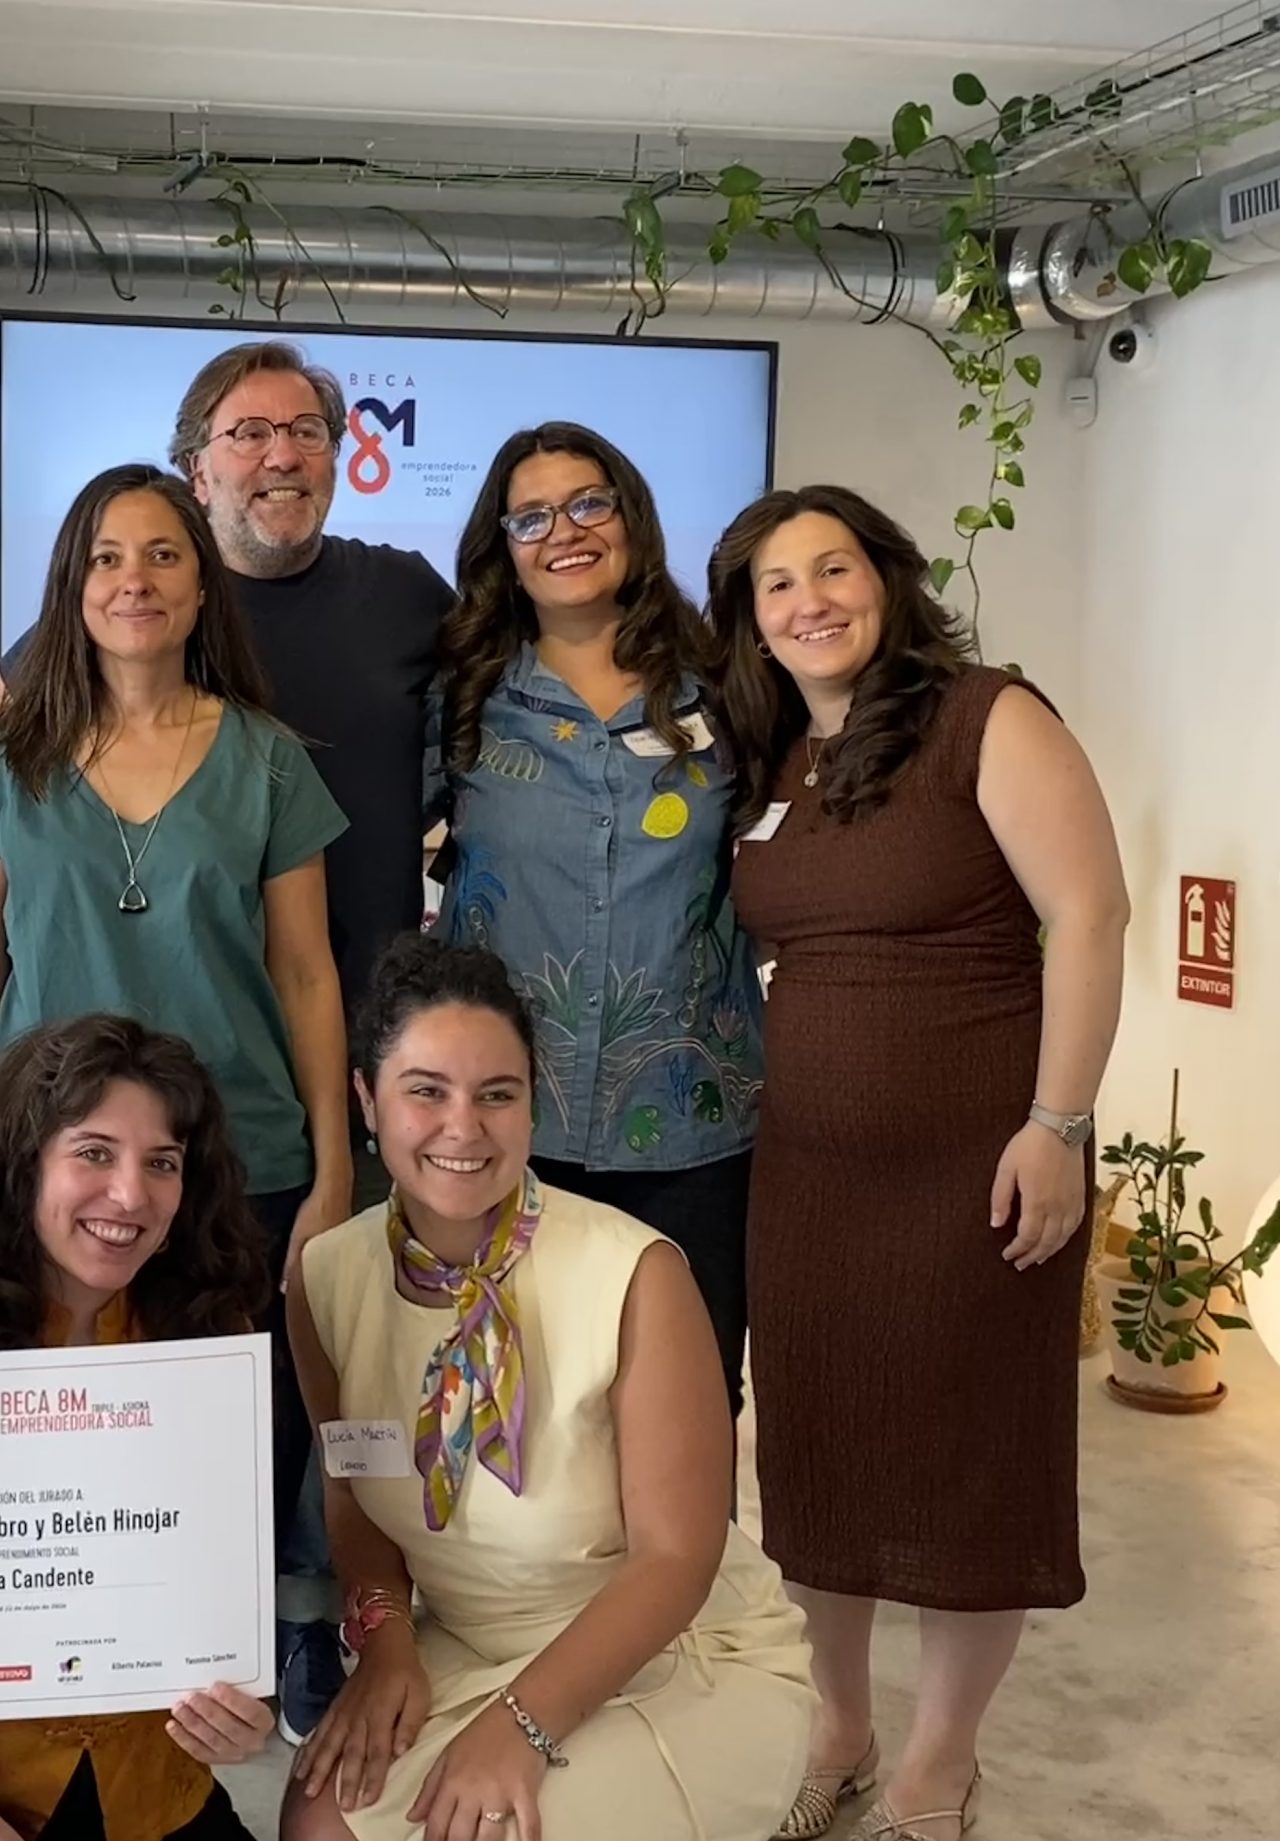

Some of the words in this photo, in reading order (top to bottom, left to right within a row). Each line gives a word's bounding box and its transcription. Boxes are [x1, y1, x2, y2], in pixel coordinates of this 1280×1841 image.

[349, 373, 416, 387] BECA
[401, 461, 477, 472] emprendedora
[423, 473, 454, 483] social
[425, 487, 451, 497] 2026
[1181, 975, 1231, 997] EXTINTOR
[0, 1389, 50, 1417] BECA
[57, 1387, 87, 1412] 8M
[0, 1413, 105, 1435] EMPRENDEDORA
[107, 1410, 154, 1429] SOCIAL
[19, 1491, 36, 1505] DEL
[38, 1488, 73, 1503] JURADO
[35, 1516, 46, 1541] y
[52, 1509, 107, 1535] Belén
[113, 1506, 180, 1535] Hinojar
[54, 1546, 80, 1558] SOCIAL
[12, 1567, 95, 1590] Candente
